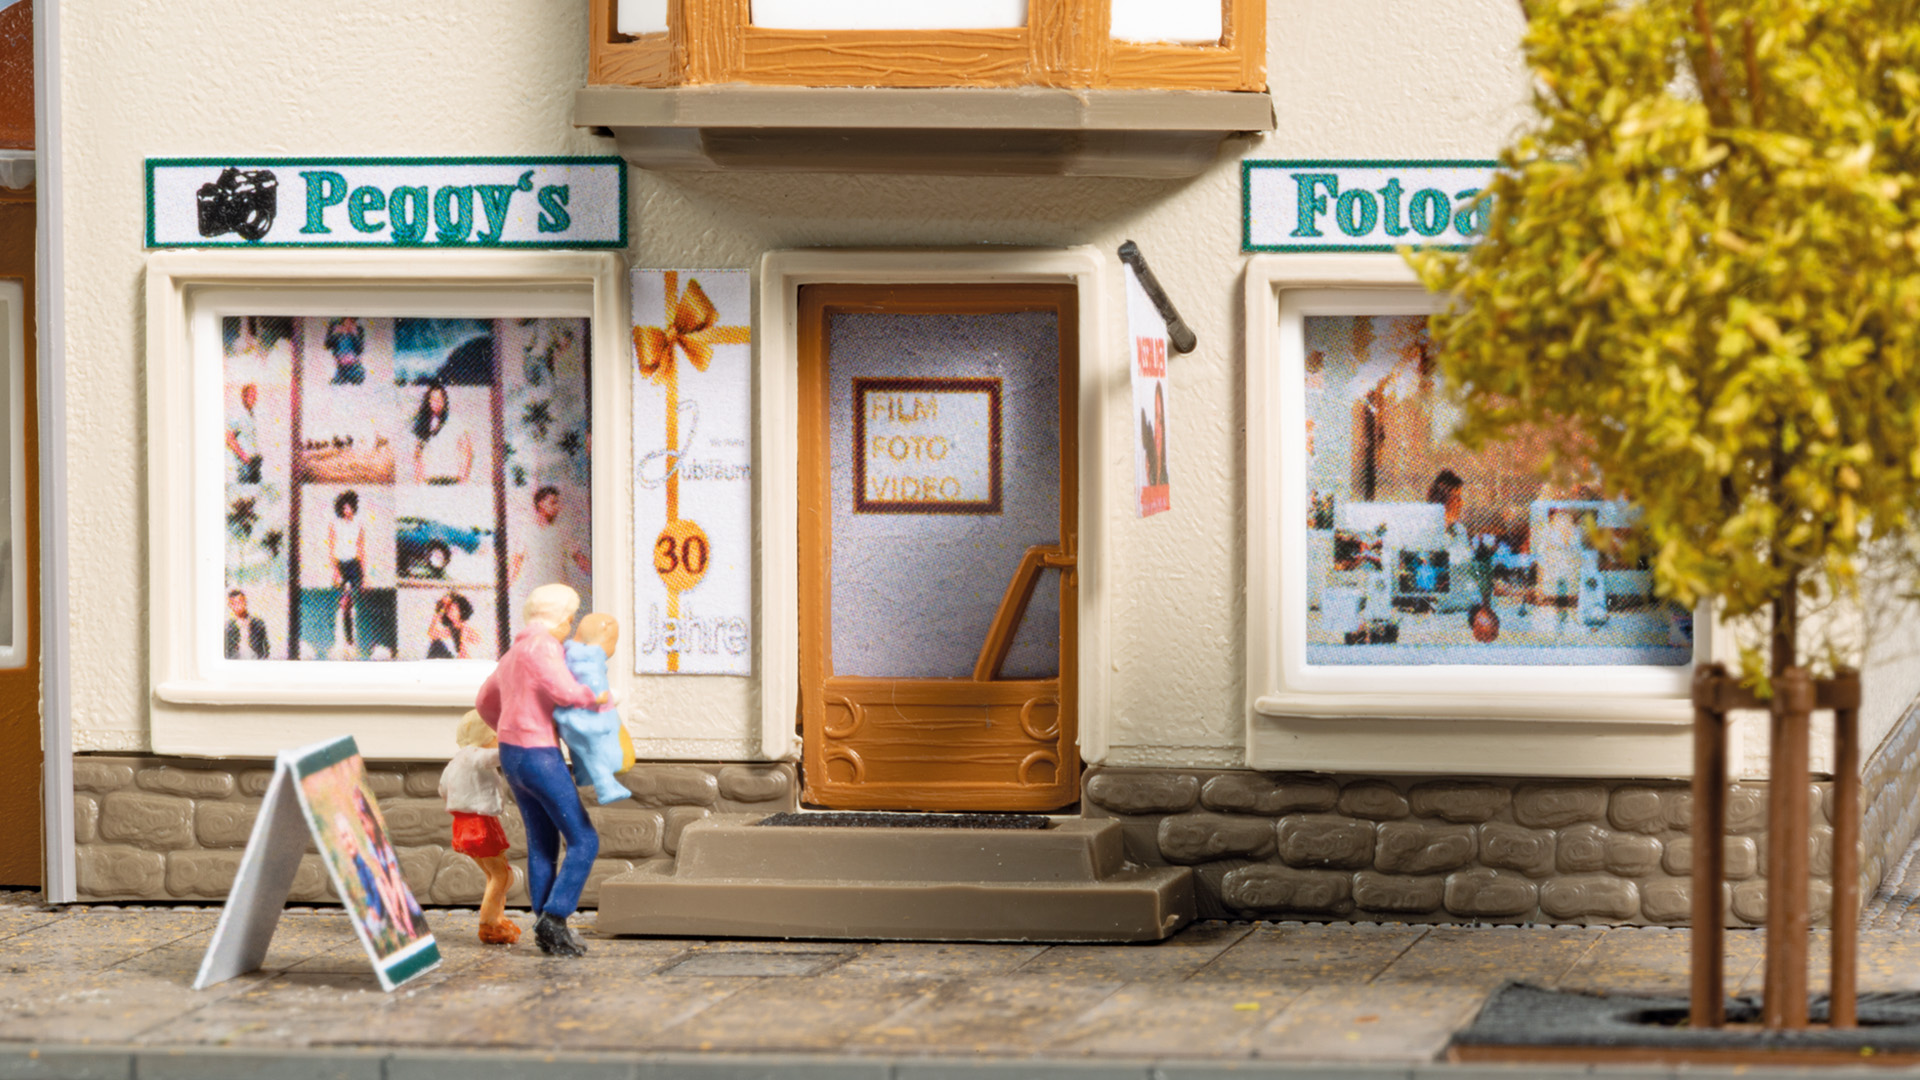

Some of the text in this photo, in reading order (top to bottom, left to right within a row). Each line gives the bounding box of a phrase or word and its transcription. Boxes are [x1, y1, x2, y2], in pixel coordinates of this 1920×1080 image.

[1289, 173, 1493, 237] Fotoa
[871, 395, 938, 422] FILM
[871, 434, 949, 463] FOTO
[871, 475, 961, 501] VIDEO
[657, 535, 708, 575] 30
[641, 602, 748, 656] Jahre
